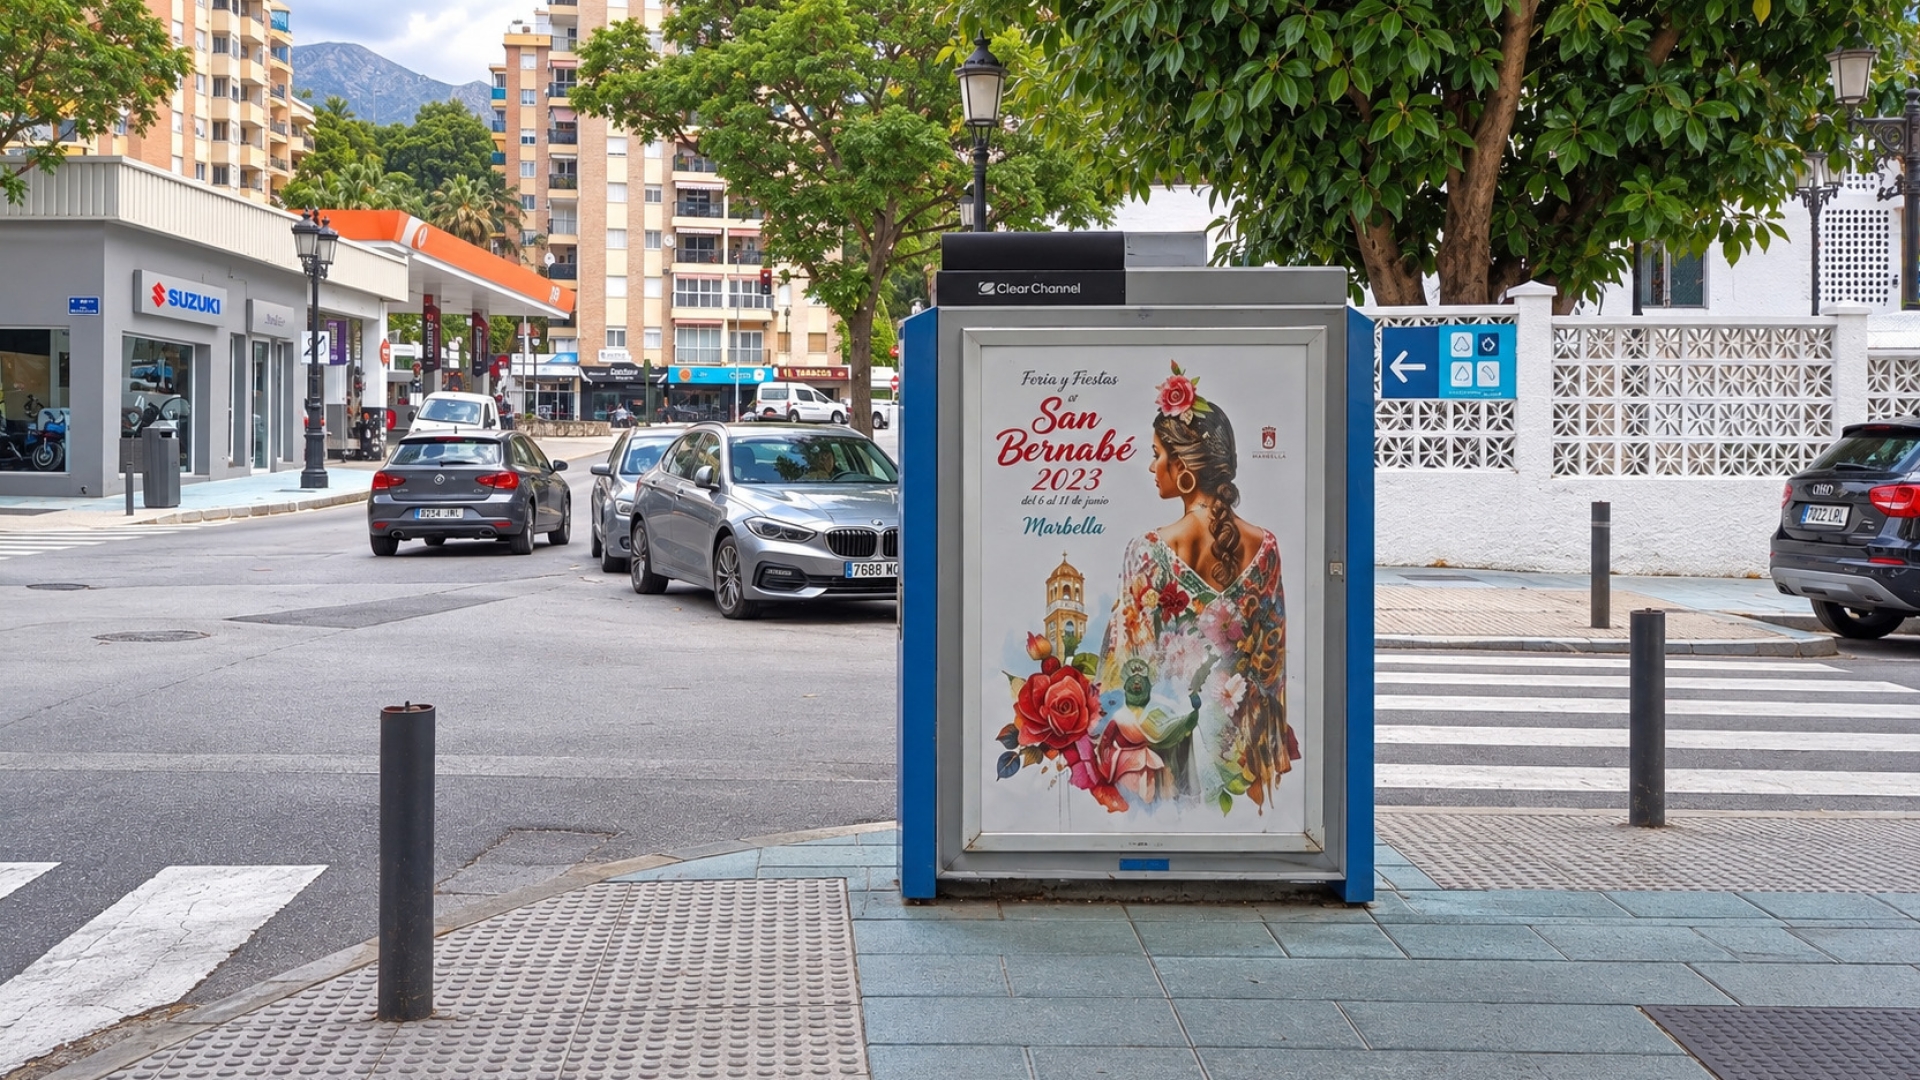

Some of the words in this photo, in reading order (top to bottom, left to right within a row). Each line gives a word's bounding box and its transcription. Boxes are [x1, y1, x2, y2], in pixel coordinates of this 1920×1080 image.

[996, 282, 1030, 295] Clear
[1030, 282, 1081, 294] Channel
[168, 288, 221, 315] SUZUKI
[1057, 376, 1069, 393] y
[1072, 369, 1119, 386] Fiestas
[1031, 396, 1102, 434] San
[996, 428, 1137, 466] Bernabé
[1031, 467, 1103, 491] 2023
[1021, 495, 1037, 505] del
[1037, 495, 1045, 505] 6
[1046, 494, 1058, 505] al
[1071, 494, 1082, 505] de
[1023, 515, 1106, 537] Marbella
[853, 563, 882, 577] 7688
